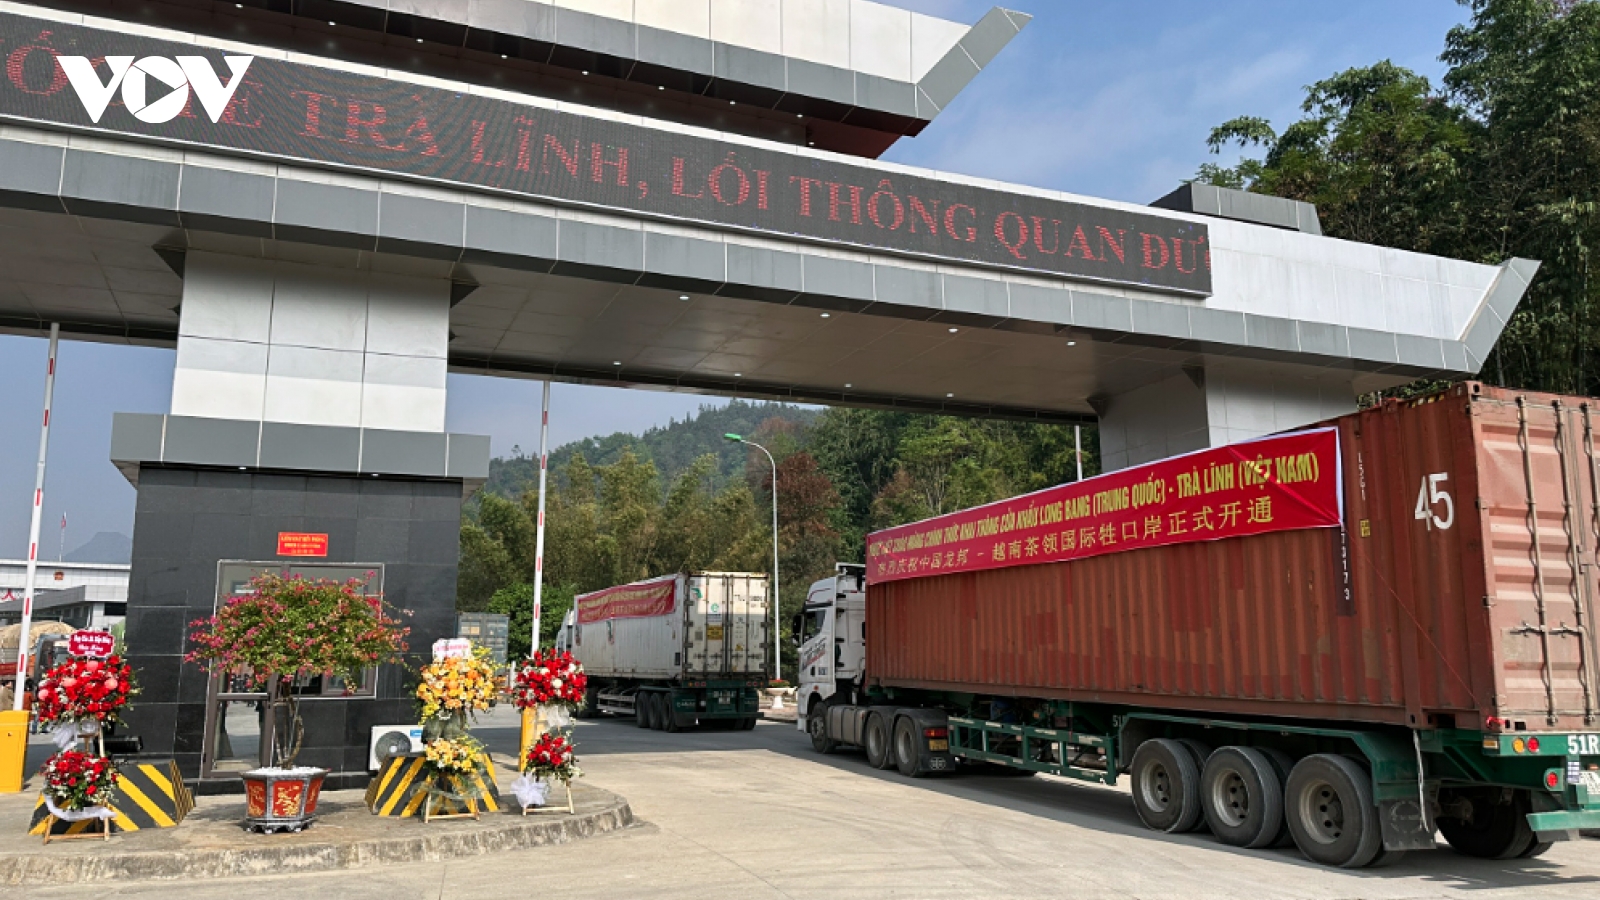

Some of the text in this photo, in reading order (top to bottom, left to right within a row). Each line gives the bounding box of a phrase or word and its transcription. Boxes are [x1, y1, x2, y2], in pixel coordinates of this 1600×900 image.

[790, 175, 977, 243] THÔNG
[994, 211, 1126, 265] QUAN
[1139, 232, 1211, 274] ĐƯ
[1040, 501, 1063, 525] LONG
[1065, 495, 1090, 520] BANG
[1093, 486, 1129, 517] (TRUNG
[1131, 472, 1166, 509] QUỐC)
[1176, 466, 1201, 499] TRÀ
[1239, 454, 1273, 490] (VIỆT
[1274, 452, 1320, 485] NAM)
[1414, 472, 1454, 532] 45
[1567, 734, 1599, 755] 51R
